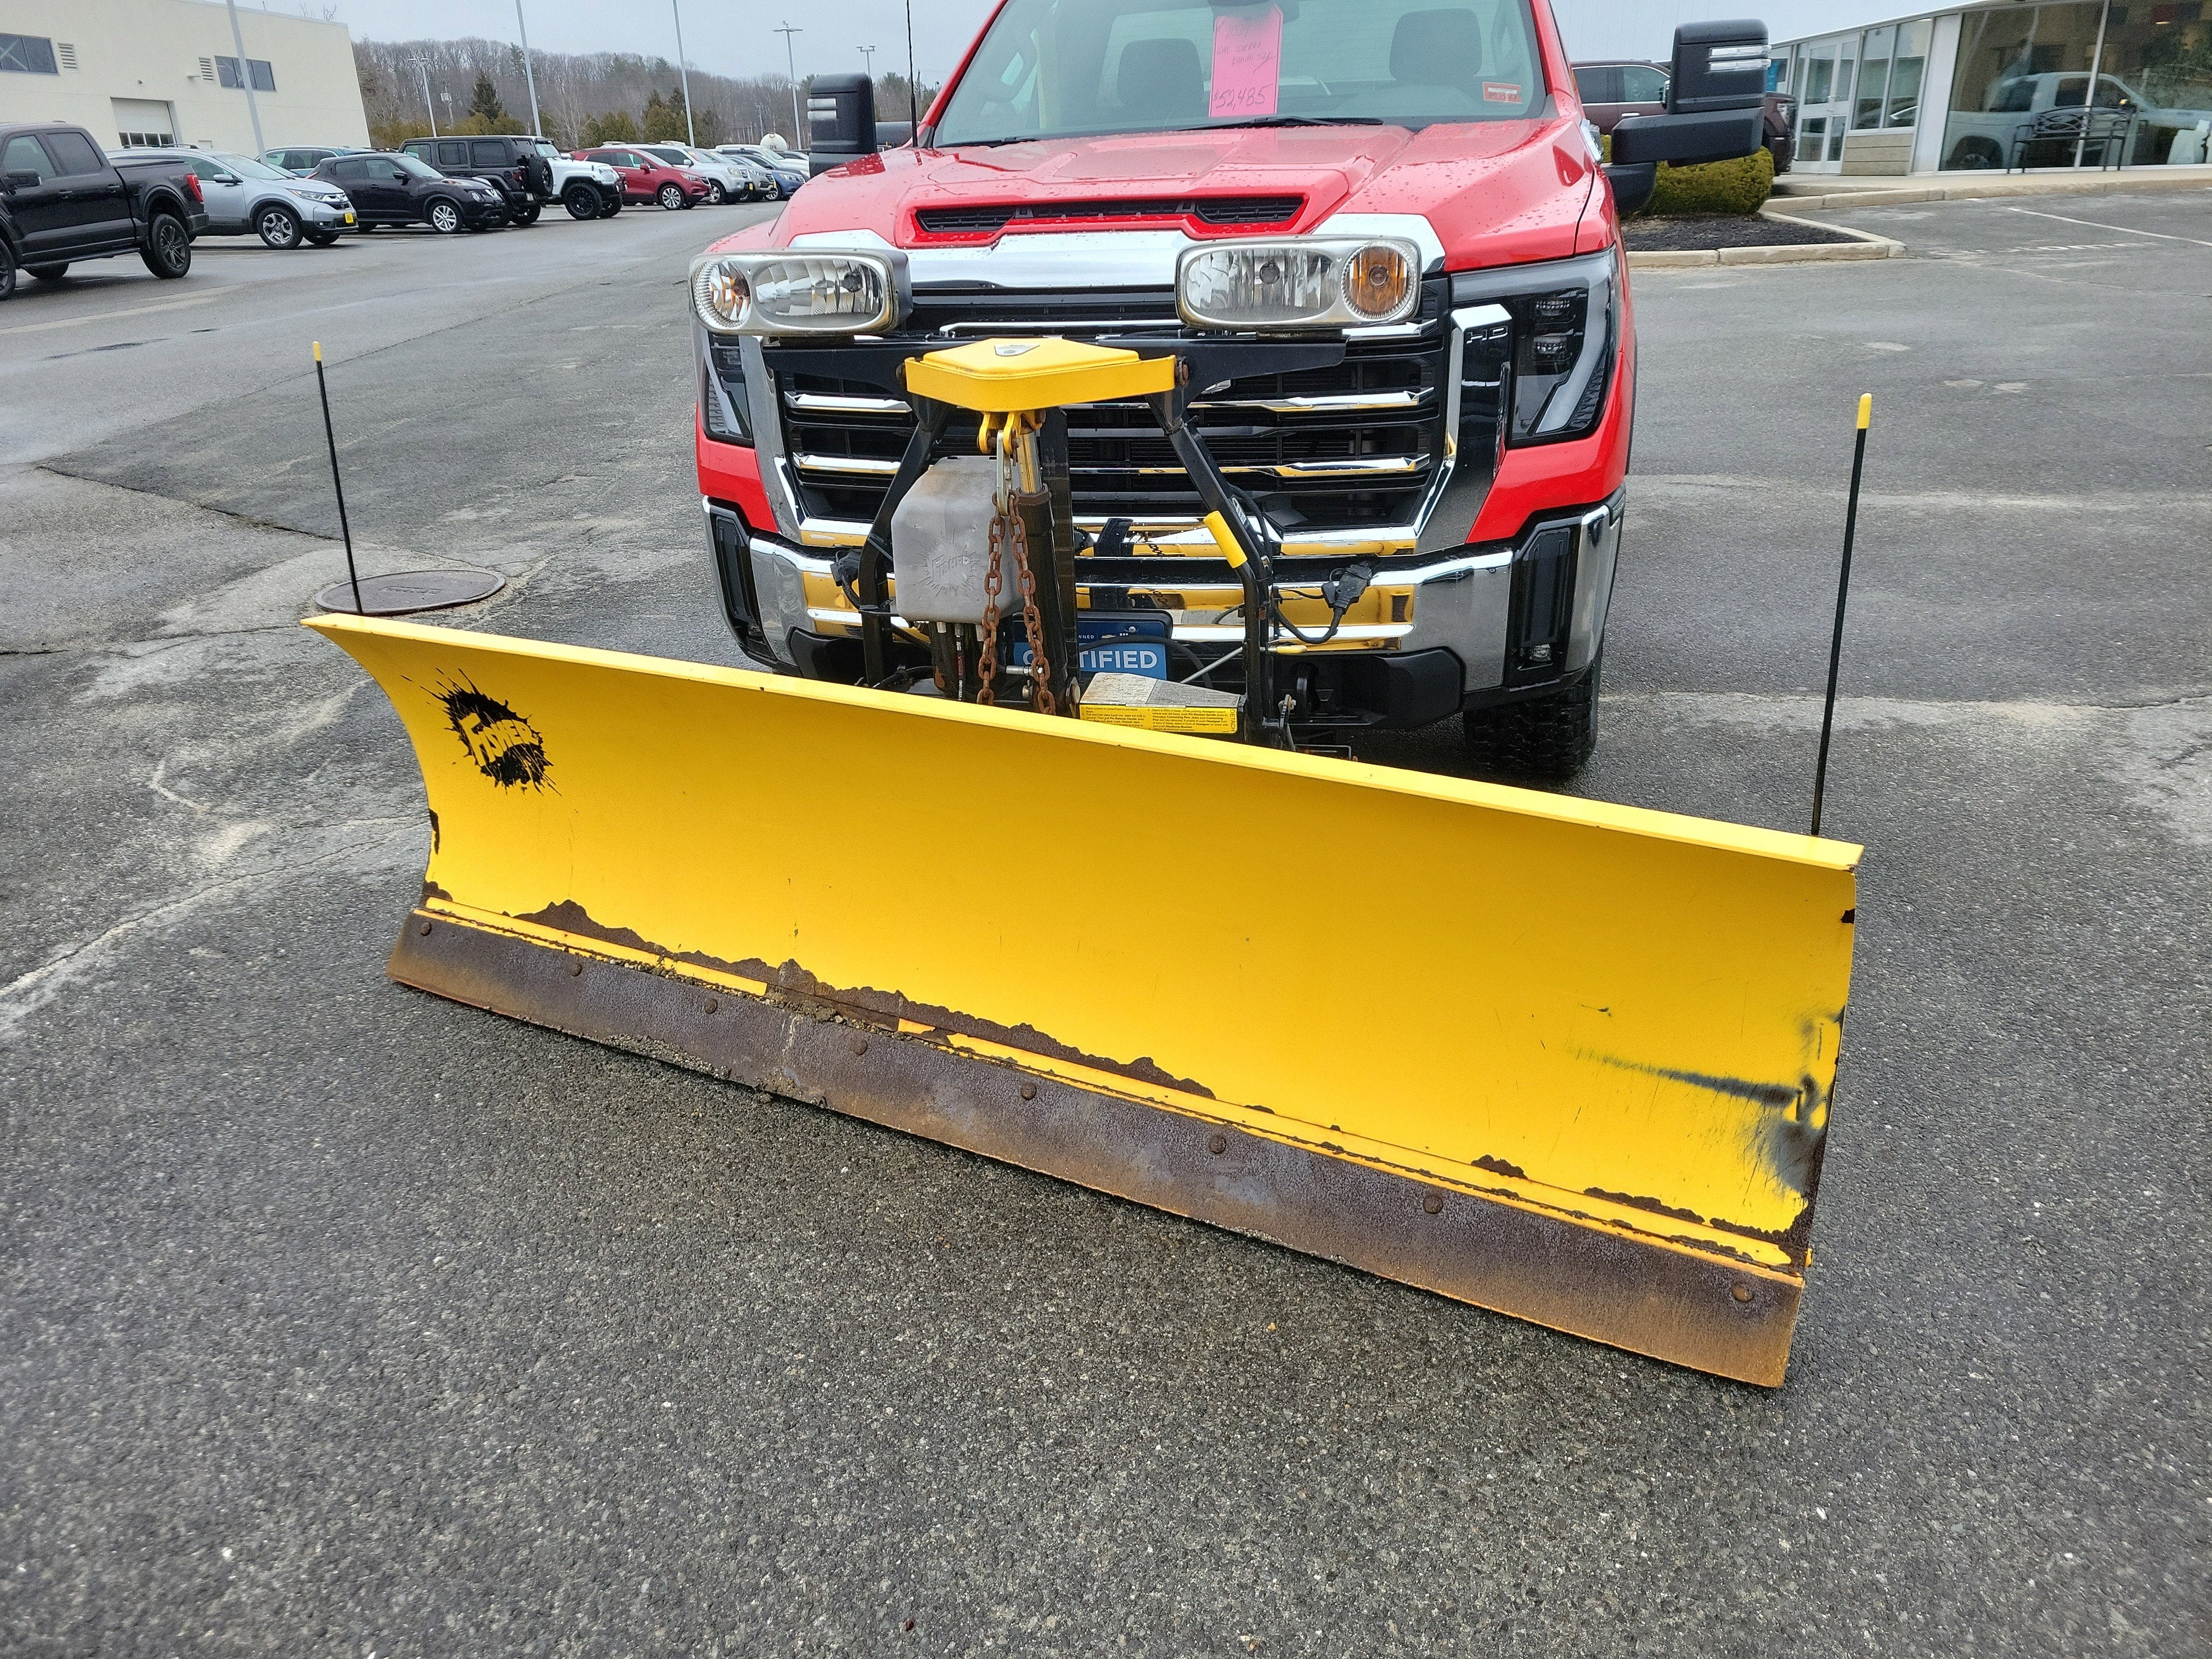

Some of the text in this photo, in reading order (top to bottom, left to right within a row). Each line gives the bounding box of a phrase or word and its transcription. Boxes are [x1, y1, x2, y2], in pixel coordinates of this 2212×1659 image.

[1214, 83, 1273, 110] $52,485
[1466, 325, 1508, 344] HD
[459, 712, 540, 766] FISHER
